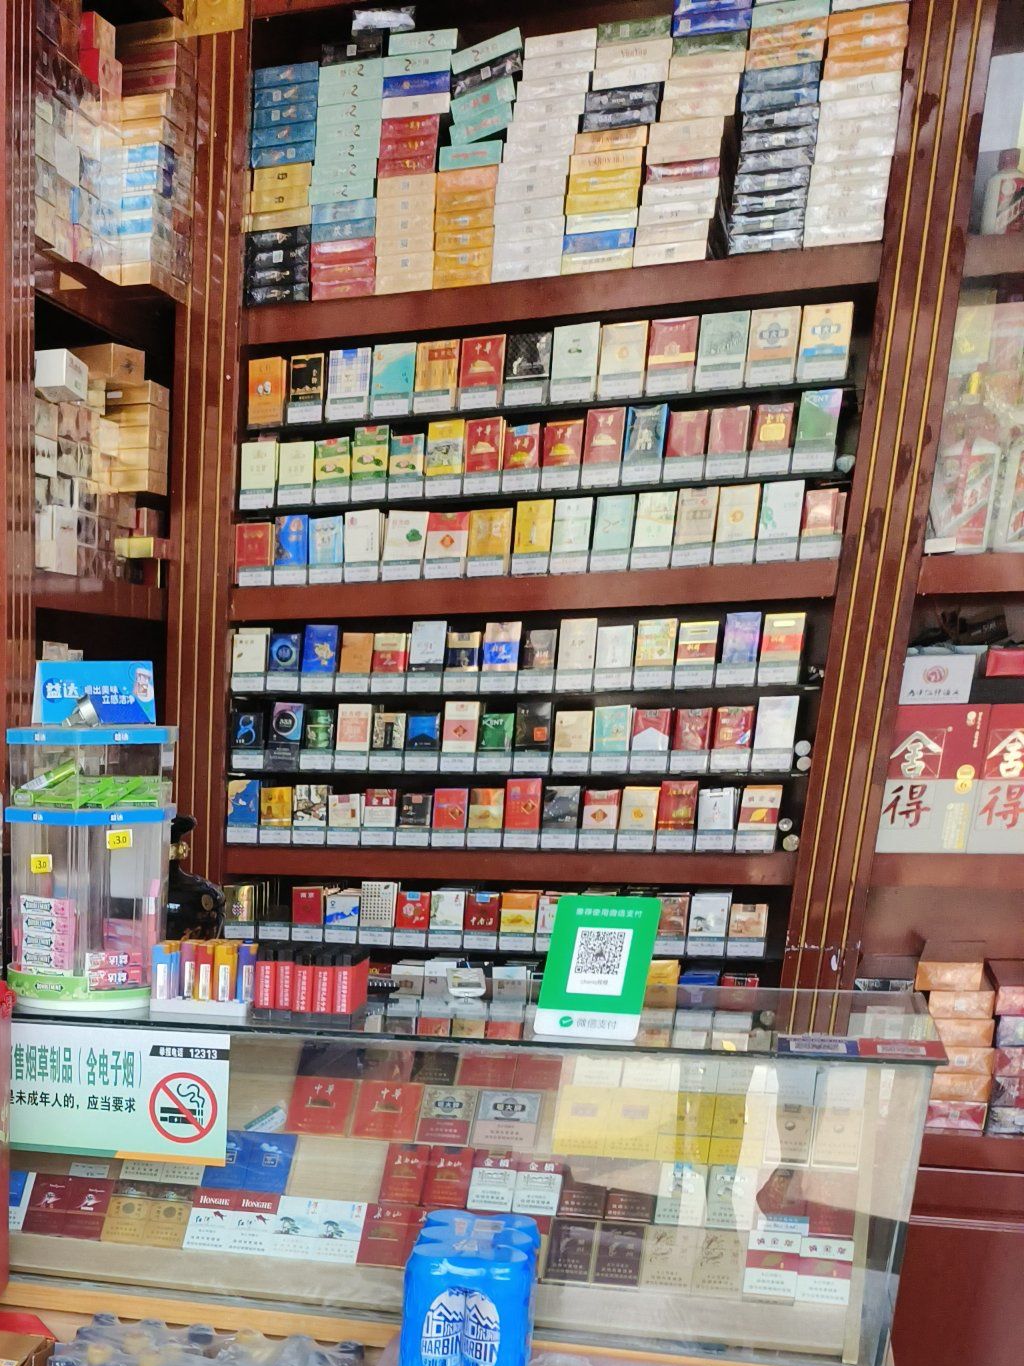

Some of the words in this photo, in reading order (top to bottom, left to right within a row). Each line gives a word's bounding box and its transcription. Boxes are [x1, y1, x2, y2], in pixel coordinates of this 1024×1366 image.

[45, 681, 79, 699] 益达
[576, 1015, 618, 1031] 微信支付
[189, 1048, 218, 1059] 12313
[10, 1044, 143, 1088] 售烟草制品（含电子烟）
[199, 1195, 230, 1206] HONGHE
[242, 1199, 273, 1209] HONGHE
